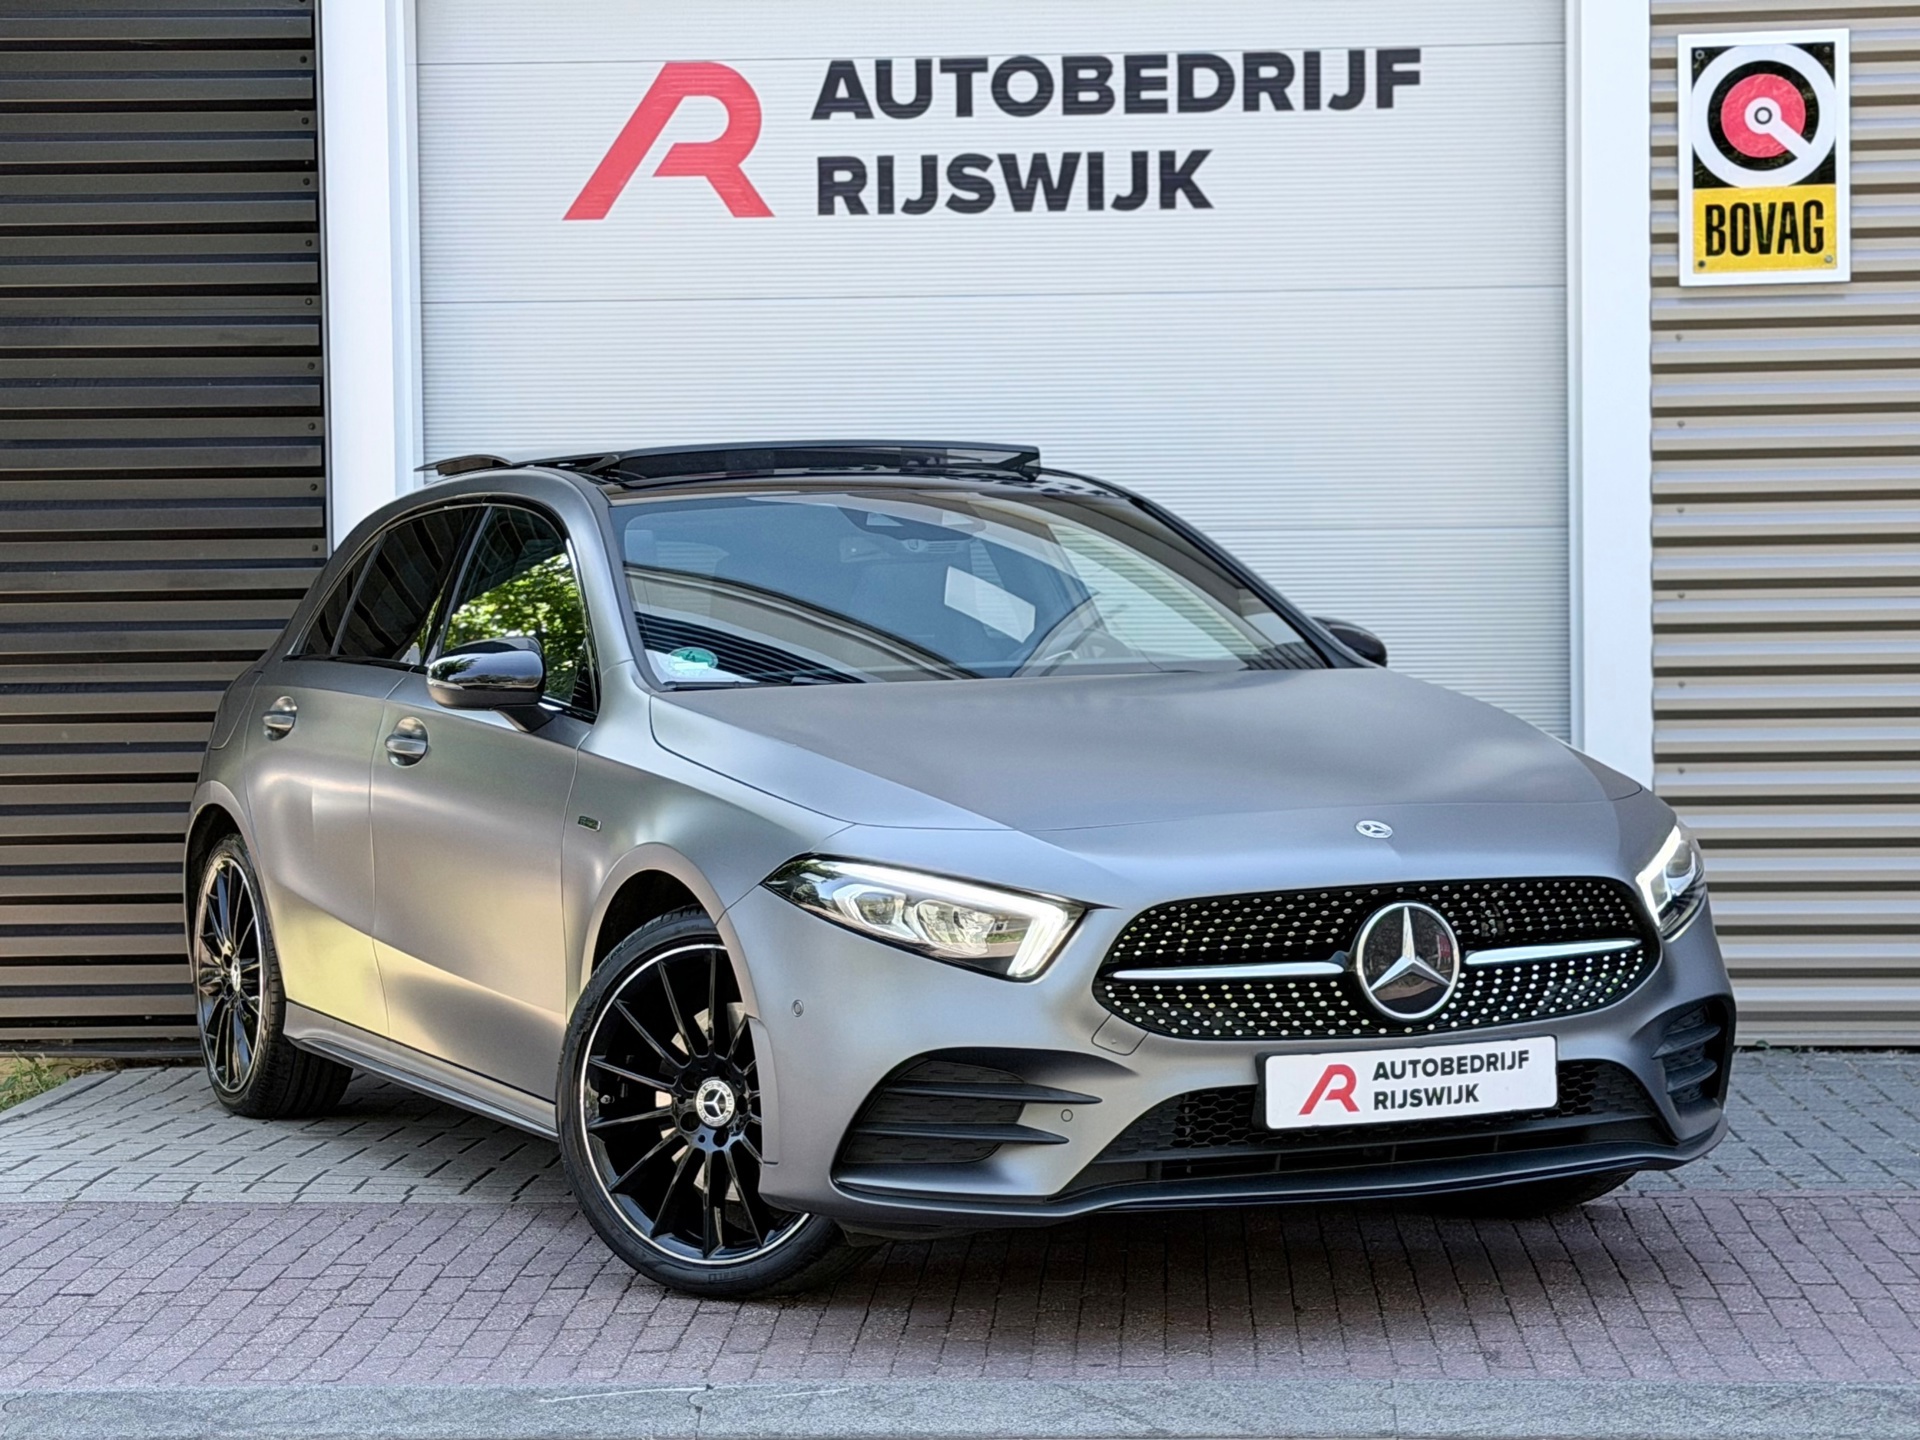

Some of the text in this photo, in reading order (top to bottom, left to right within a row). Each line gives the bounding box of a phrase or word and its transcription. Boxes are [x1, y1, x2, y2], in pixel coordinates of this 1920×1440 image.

[812, 48, 1420, 120] AUTOBEDRIJF
[817, 149, 1213, 216] RIJSWIJK
[1705, 200, 1824, 257] BOVAG
[1372, 1050, 1529, 1081] AUTOBEDRIJF
[1373, 1083, 1479, 1110] RIJSWIJK
